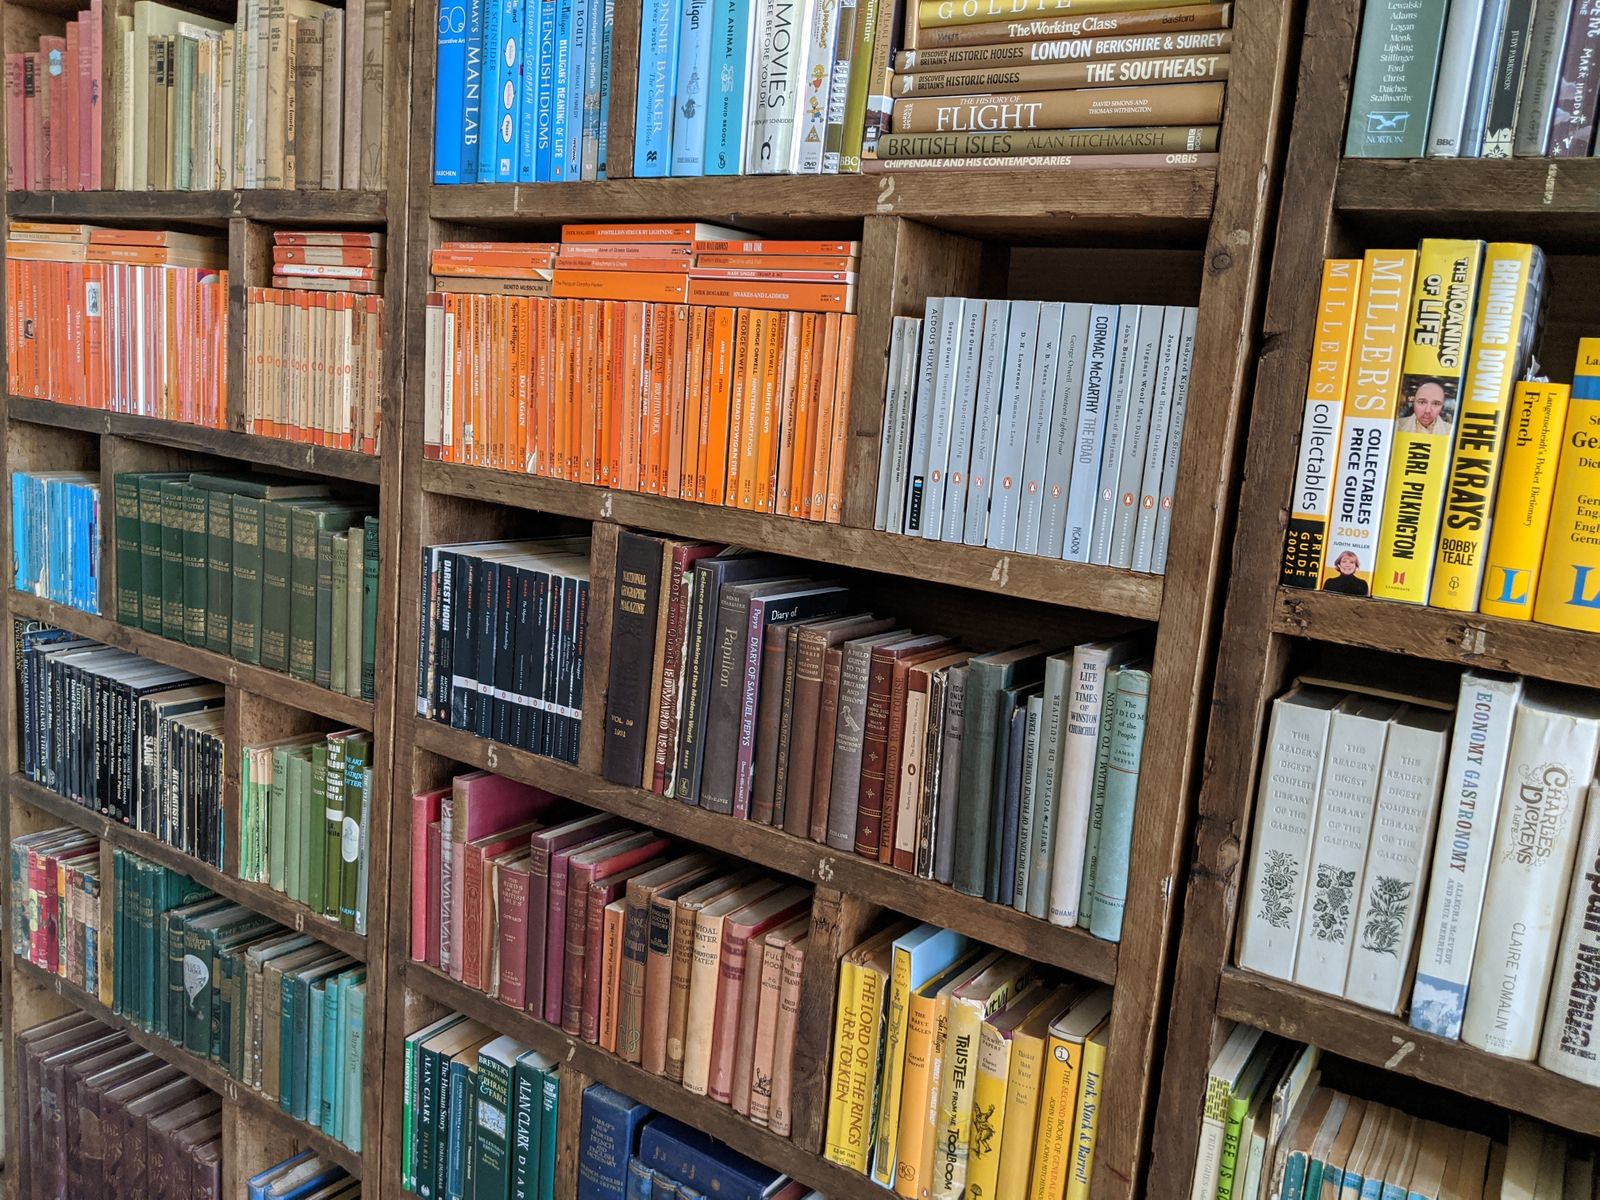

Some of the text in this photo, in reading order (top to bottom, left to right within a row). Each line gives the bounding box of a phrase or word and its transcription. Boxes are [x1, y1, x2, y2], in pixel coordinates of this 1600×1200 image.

[1008, 23, 1030, 37] The
[1030, 19, 1081, 36] Working
[1082, 17, 1117, 32] Class
[1390, 11, 1418, 20] Adams
[1390, 22, 1415, 32] Logan
[725, 18, 735, 58] ANIMAL
[949, 33, 1225, 62] HISTORIC HOUSES LONDON BERKSHIRE & SURREY
[1384, 43, 1414, 53] Lipking
[1389, 34, 1411, 42] Monk
[759, 20, 772, 110] BEFORE YOU DIE
[767, 3, 793, 109] MOVIES
[946, 56, 1219, 87] HISTORIC HOUSES THE SOUTHEAST
[1379, 53, 1415, 63] Stillinger
[1387, 64, 1405, 73] Ford
[538, 20, 553, 149] ENGLISH IDIOMS
[1382, 74, 1406, 83] Christ
[464, 46, 481, 146] MAN LAB
[554, 39, 568, 159] MILLIGAN'S MEANING OF LIFE
[653, 60, 666, 136] BARKER
[1370, 93, 1413, 103] Stallworthy
[936, 103, 1042, 131] FLIGHT
[888, 132, 1165, 156] BRITISH ISLES ALAN TITCHMARSH
[1366, 135, 1404, 144] NORTON
[1436, 138, 1455, 146] BBC
[840, 156, 858, 166] BBC
[884, 153, 1198, 169] CHIPPENDALE AND HIS CONTEMPORARIES ORBIS
[233, 193, 243, 215] 2
[877, 175, 895, 212] 2
[1414, 274, 1443, 347] OF LIFE
[1440, 257, 1469, 369] THE MOANING
[769, 317, 778, 347] GEORGE
[1314, 262, 1350, 394] MILLER'S
[1354, 257, 1405, 412] MILLER'S
[924, 308, 938, 384] ALDOUS HUXLEY
[767, 348, 776, 378] ORWELL
[518, 375, 525, 389] DO
[1079, 316, 1108, 465] CORMAC McCARTHY THE ROAD
[1446, 259, 1522, 532] BRINGING DOWN THE KRAYS
[518, 400, 526, 426] AGAIN
[1517, 391, 1541, 447] French
[1341, 428, 1364, 523] PRICE GUIDE
[1357, 428, 1382, 525] COLLECTABLES
[600, 492, 613, 517] 3
[1392, 441, 1432, 560] KARL PILKINGTON
[1070, 526, 1082, 555] PICADOR
[1336, 527, 1370, 539] 2009
[1442, 538, 1478, 553] BOBBY
[1283, 530, 1298, 576] 2002/3
[1296, 532, 1310, 577] GUIDE
[1308, 533, 1323, 578] PRICE
[1442, 551, 1473, 567] TEALE
[442, 559, 453, 632] DARKEST HOUR
[1503, 569, 1527, 604] L
[771, 606, 798, 621] Diary of
[720, 626, 738, 688] Papillon
[1083, 663, 1097, 671] THE
[742, 608, 761, 747] Pepys DIARY OF SAMUEL PEPYS
[1079, 671, 1098, 683] LIFE
[1080, 683, 1094, 691] AND
[1075, 692, 1098, 703] TIMES
[1079, 703, 1090, 711] OF
[1103, 691, 1116, 732] CAXTON
[655, 667, 675, 765] EDWARD LEAR
[1068, 723, 1097, 737] CHURCHILL
[1070, 711, 1097, 724] WINSTON
[144, 735, 154, 766] SLANG
[1101, 736, 1110, 750] TO
[1117, 730, 1137, 741] People
[488, 744, 497, 768] 5
[1096, 762, 1107, 799] WILLIAM
[1450, 692, 1493, 873] ECONOMY GASTRONOMY
[1093, 804, 1104, 830] FROM
[1517, 783, 1543, 865] DICKENS
[1536, 766, 1568, 859] CHARLES
[1506, 922, 1526, 970] CLAIRE
[1495, 974, 1517, 1030] TOMALIN
[566, 1038, 577, 1062] 7
[847, 974, 876, 1147] THE LORD OF THE RINGS
[952, 1034, 970, 1090] TRUSTEE
[1385, 1036, 1416, 1069] 7
[422, 1054, 432, 1124] ALAN CLARK
[835, 1044, 854, 1104] TOLKIEN
[440, 1077, 448, 1108] Human
[950, 1091, 959, 1113] FROM
[438, 1109, 447, 1132] Story
[517, 1077, 533, 1151] ALAN CLARK
[1075, 1070, 1100, 1185] Lock, Stock & Barrel!
[944, 1128, 960, 1191] TOOLROOM
